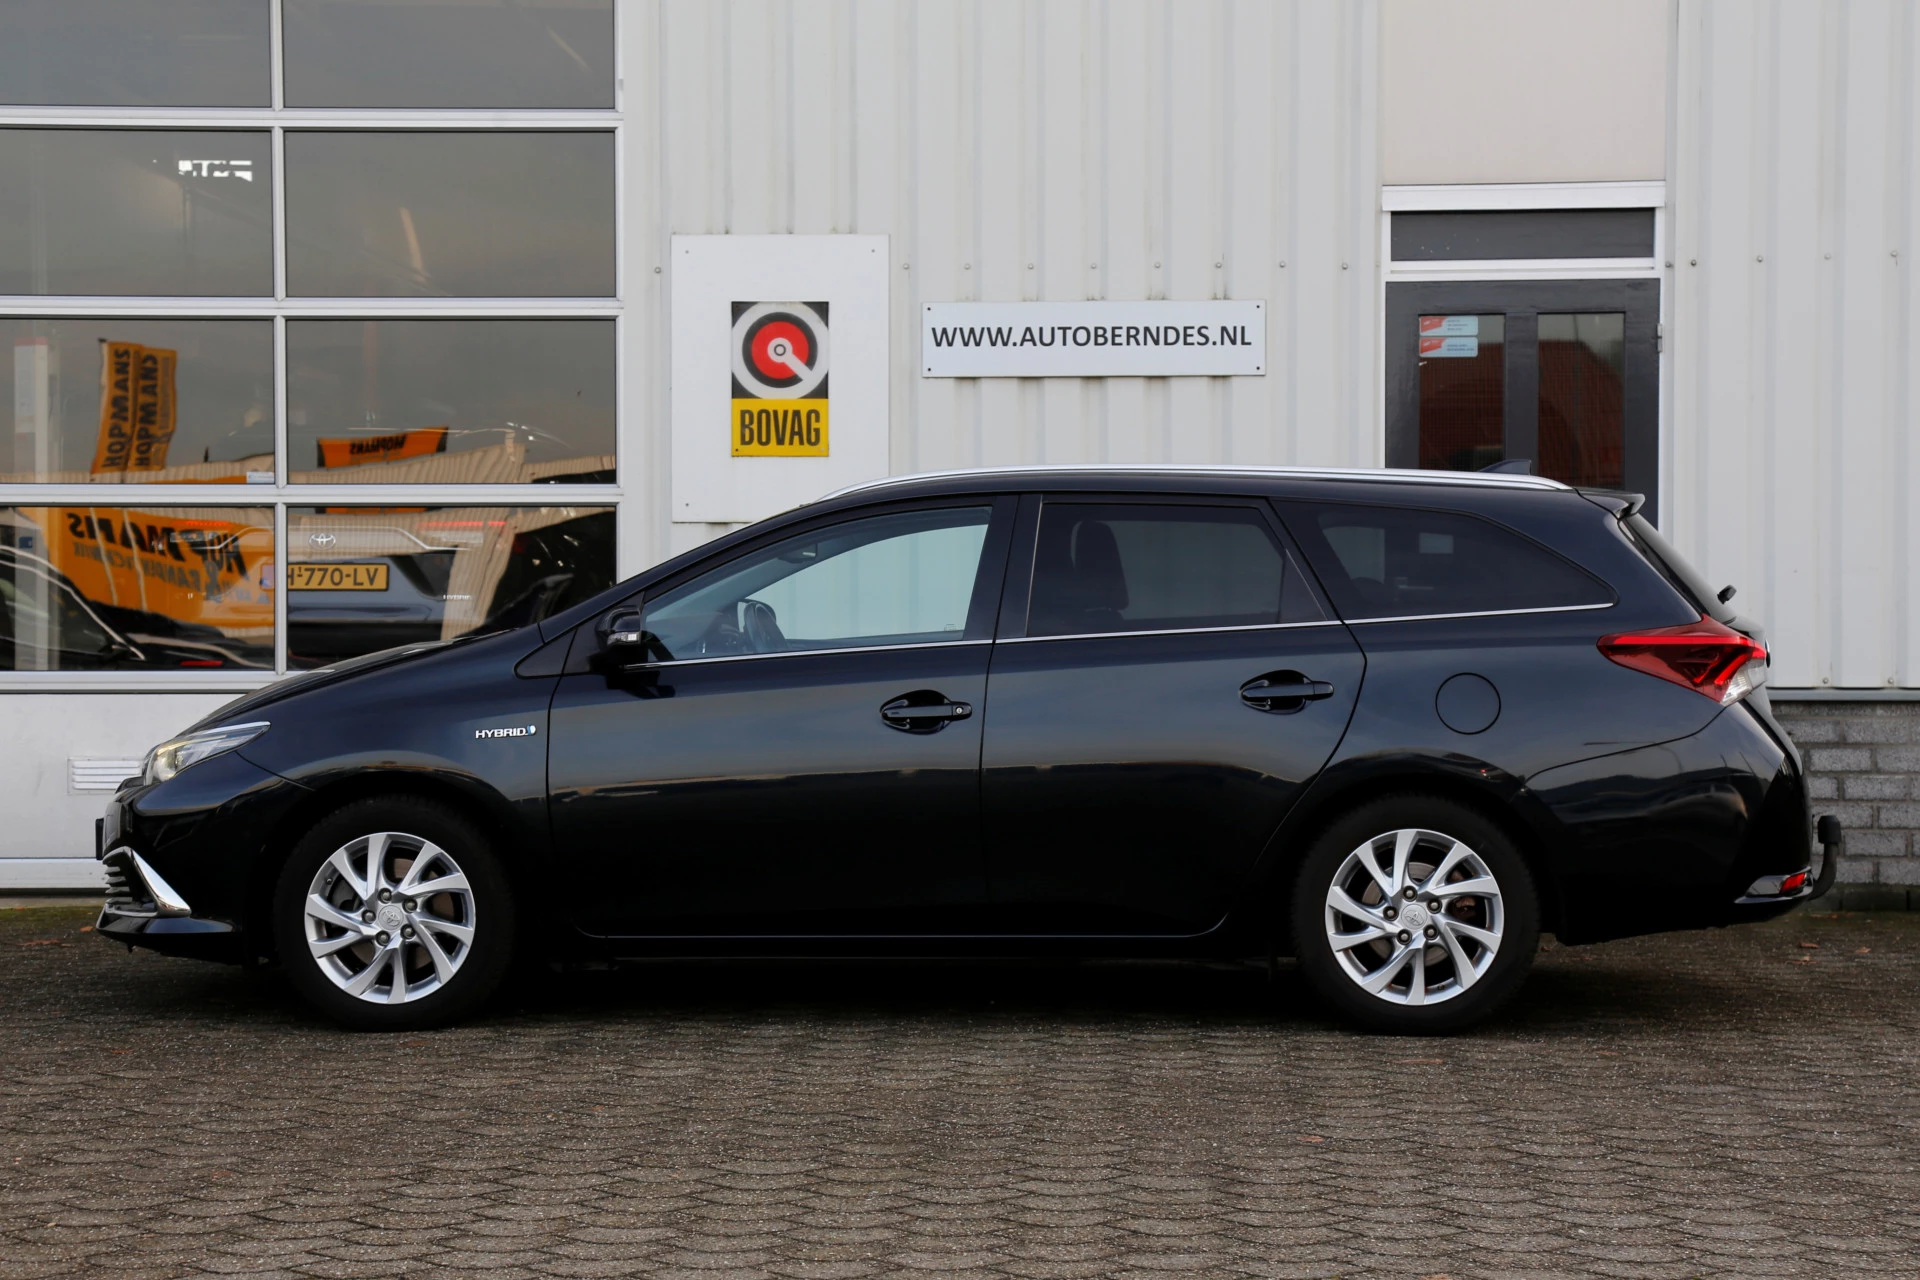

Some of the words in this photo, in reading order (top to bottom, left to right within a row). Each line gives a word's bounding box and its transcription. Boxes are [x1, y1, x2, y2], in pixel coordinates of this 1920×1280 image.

[931, 326, 1252, 347] WWW.AUTOBERNDES.NL
[102, 348, 131, 467] HOPMANS
[740, 408, 821, 446] BOVAG
[475, 727, 526, 739] HYBRID
